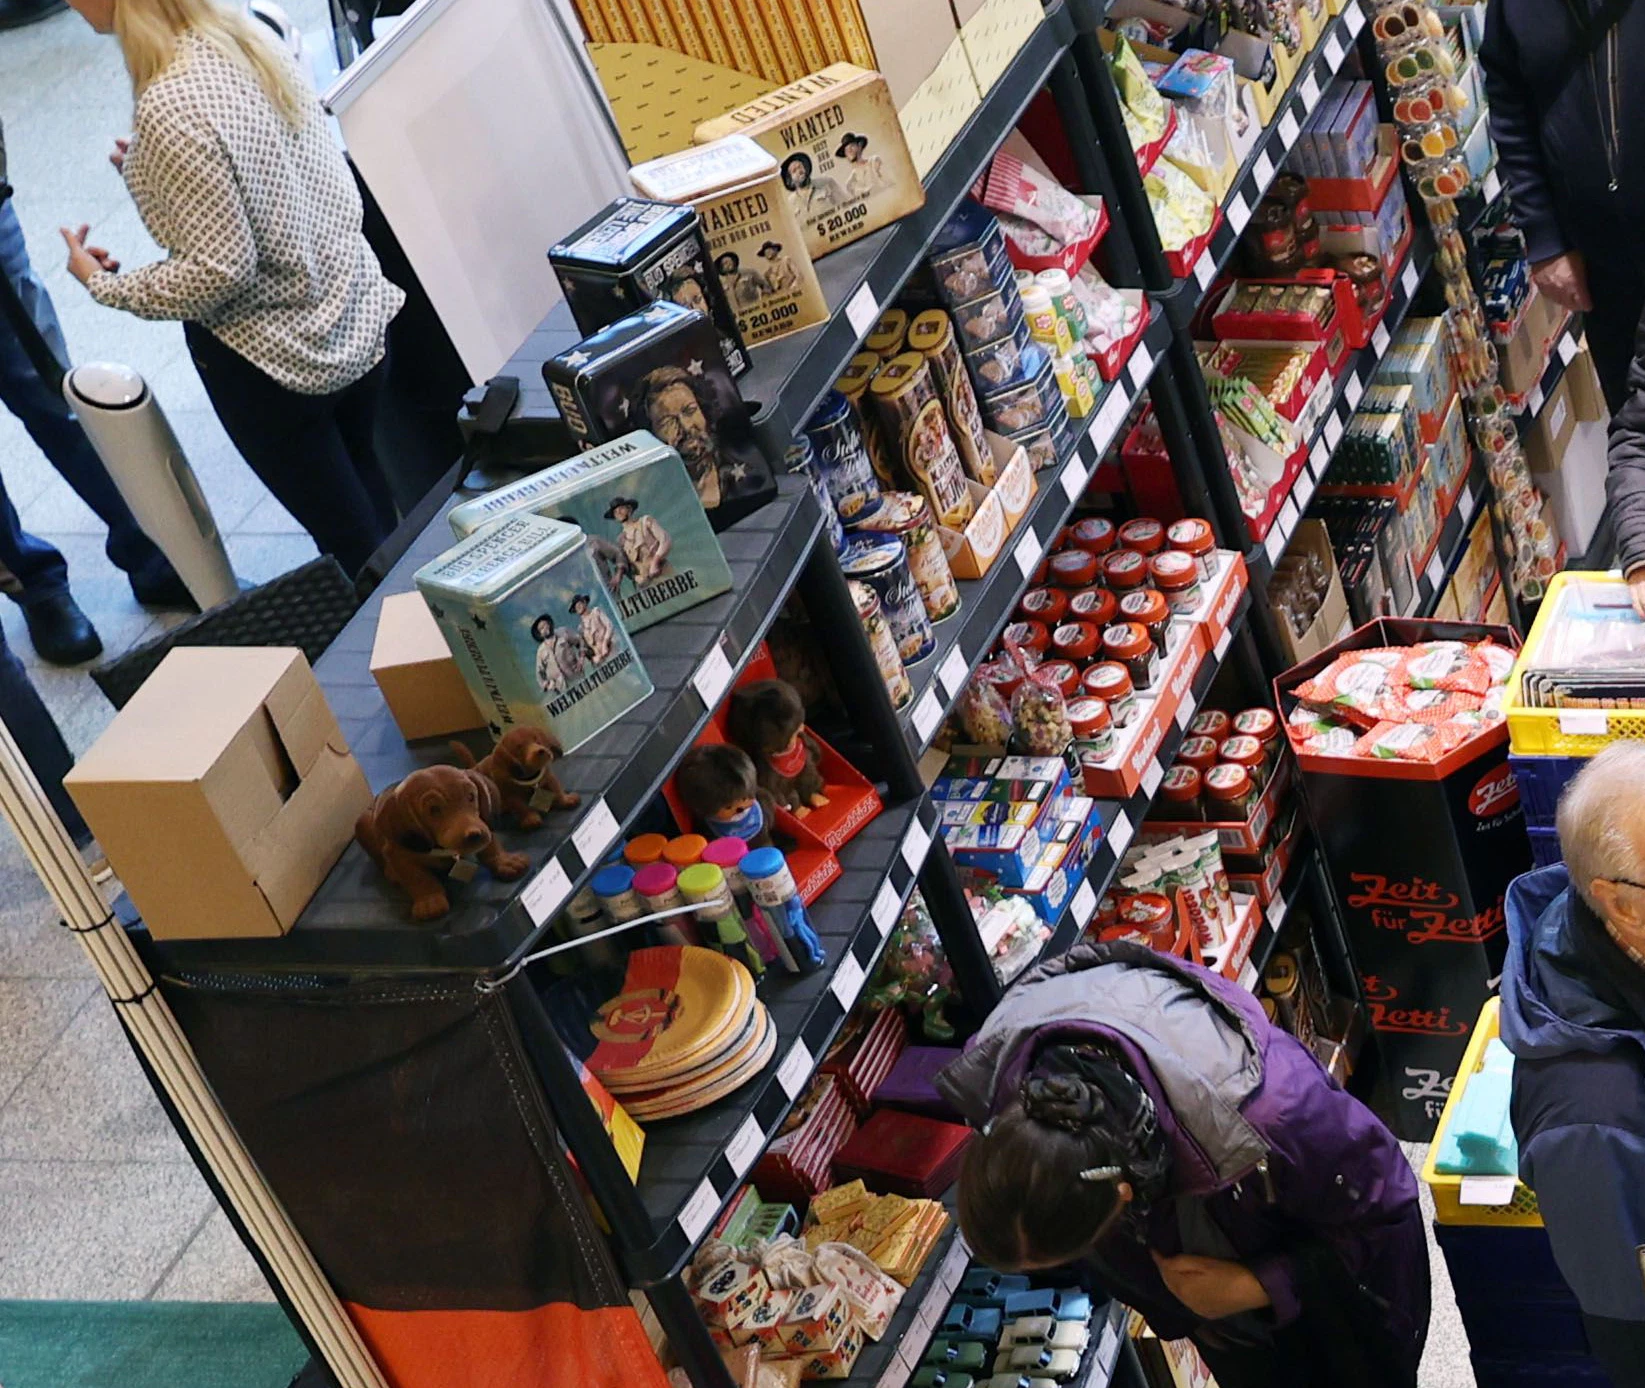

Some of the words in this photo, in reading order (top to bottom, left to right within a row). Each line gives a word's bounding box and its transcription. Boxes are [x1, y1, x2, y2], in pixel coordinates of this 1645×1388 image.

[780, 104, 845, 150] WANTED
[552, 382, 588, 435] BUD
[1347, 872, 1460, 909] Zeit
[1371, 909, 1408, 931] für
[1407, 895, 1506, 946] Zetti
